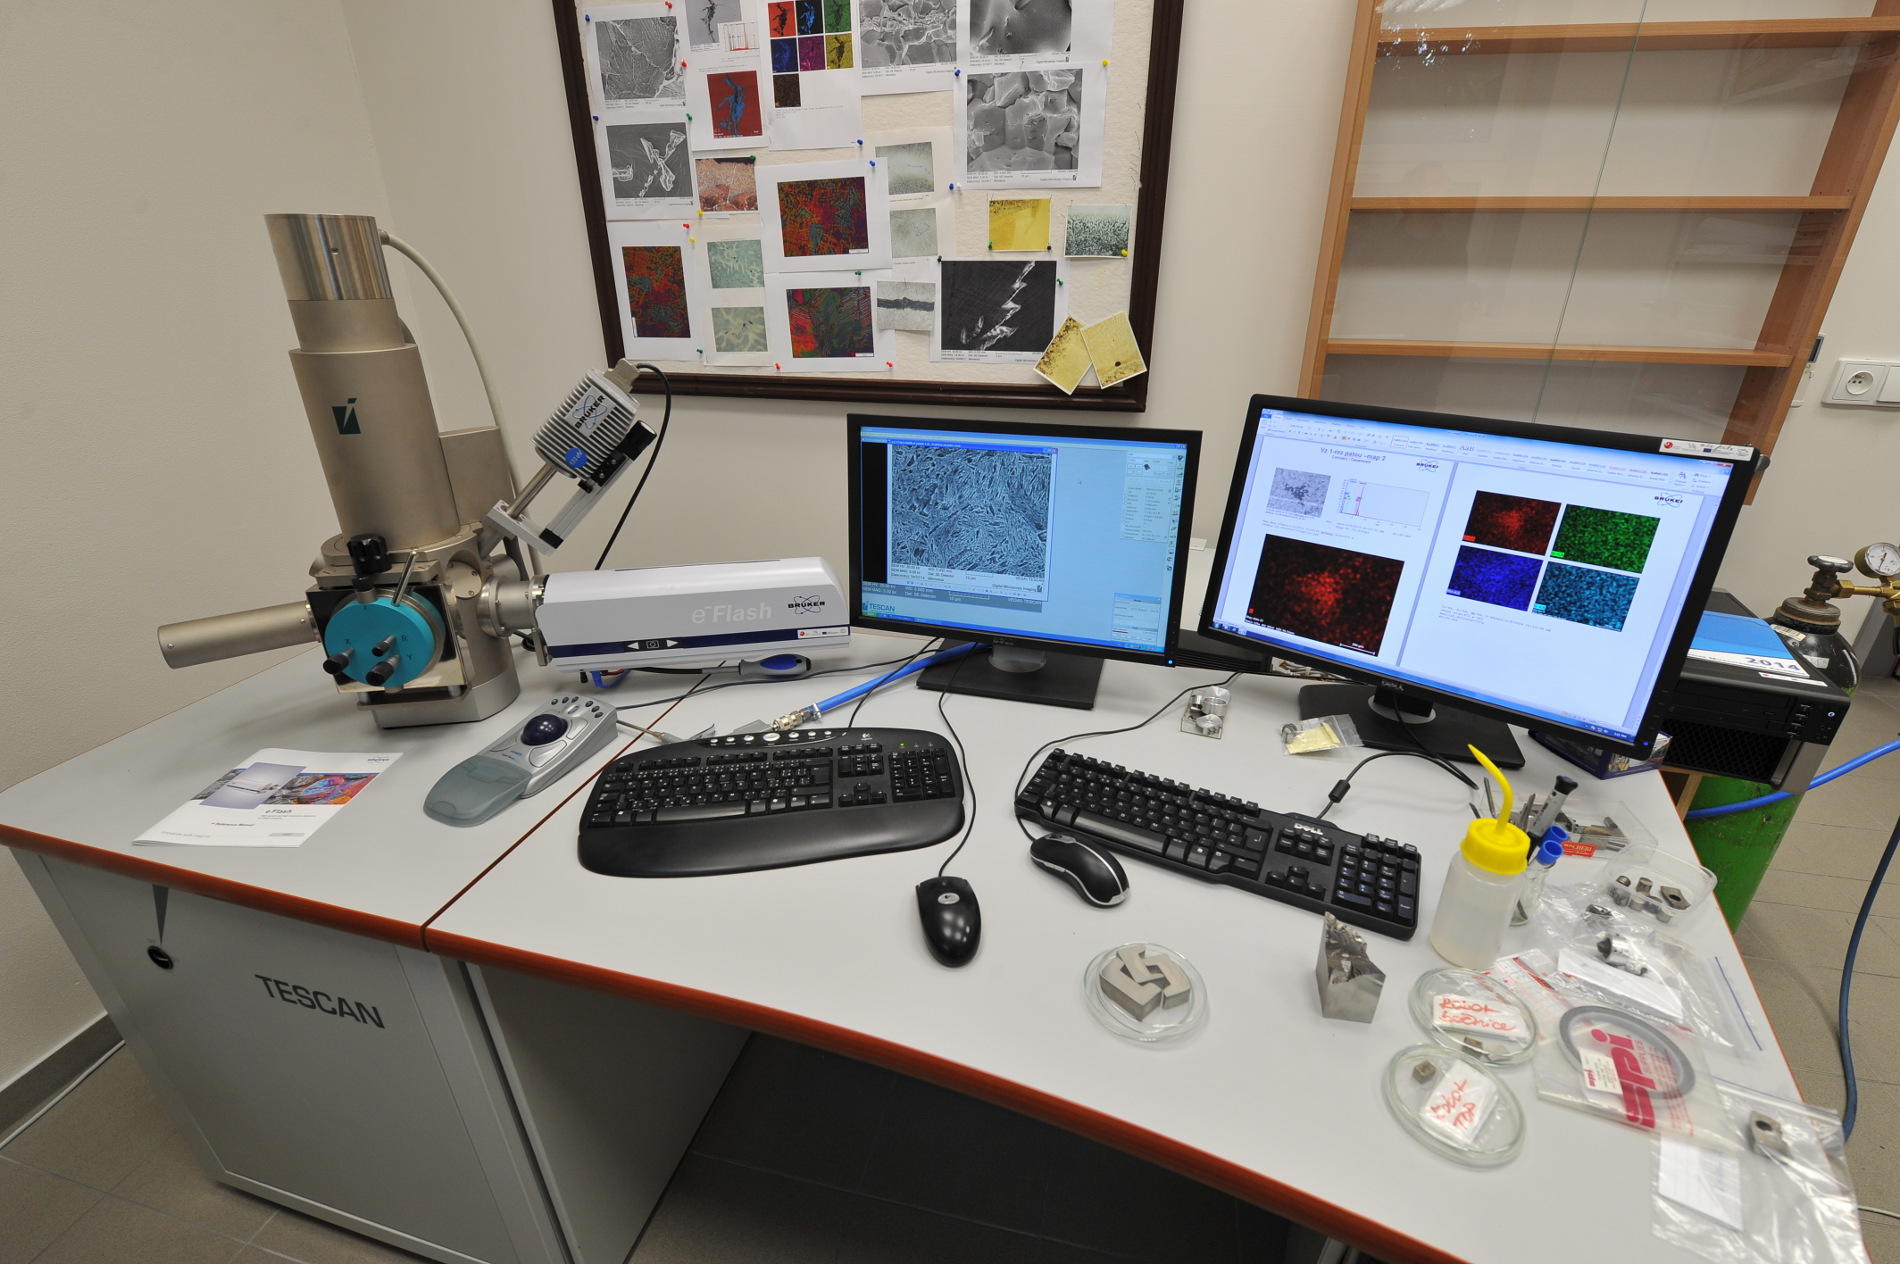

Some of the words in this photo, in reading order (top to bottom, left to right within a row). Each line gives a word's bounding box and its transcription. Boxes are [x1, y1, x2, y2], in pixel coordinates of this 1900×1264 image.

[574, 395, 606, 429] BRUKER
[787, 600, 826, 609] BRUKER
[869, 602, 896, 612] TESCAN
[1745, 656, 1801, 672] 2014
[1294, 823, 1324, 836] DELL
[254, 974, 386, 1029] TESCAN
